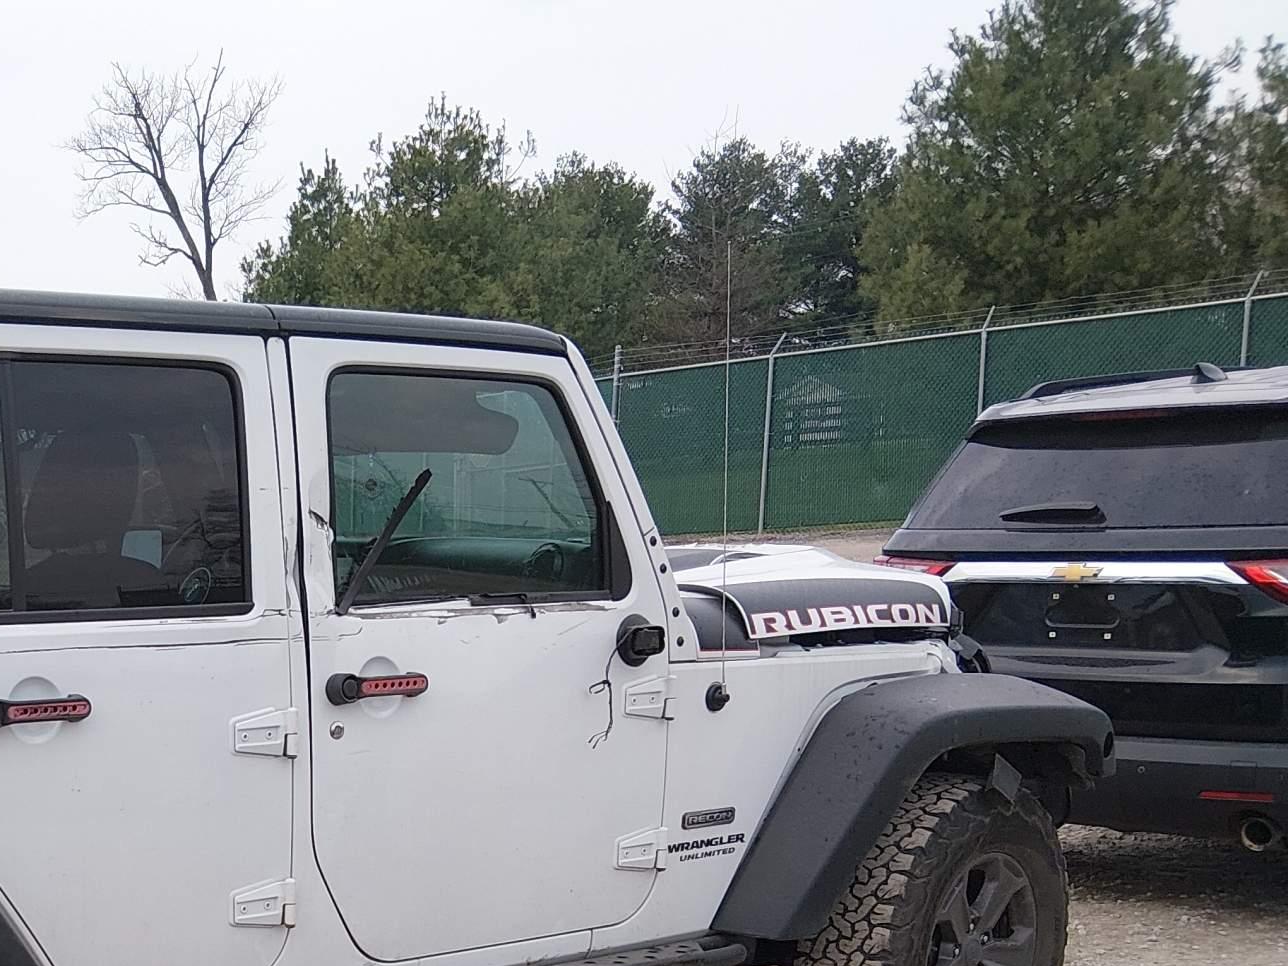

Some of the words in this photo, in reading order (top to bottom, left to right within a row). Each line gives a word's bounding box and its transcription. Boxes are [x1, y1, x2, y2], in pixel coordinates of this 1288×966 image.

[750, 602, 942, 636] RUBICON
[667, 833, 745, 854] WRANGLER
[679, 846, 736, 862] UNLIMITED
